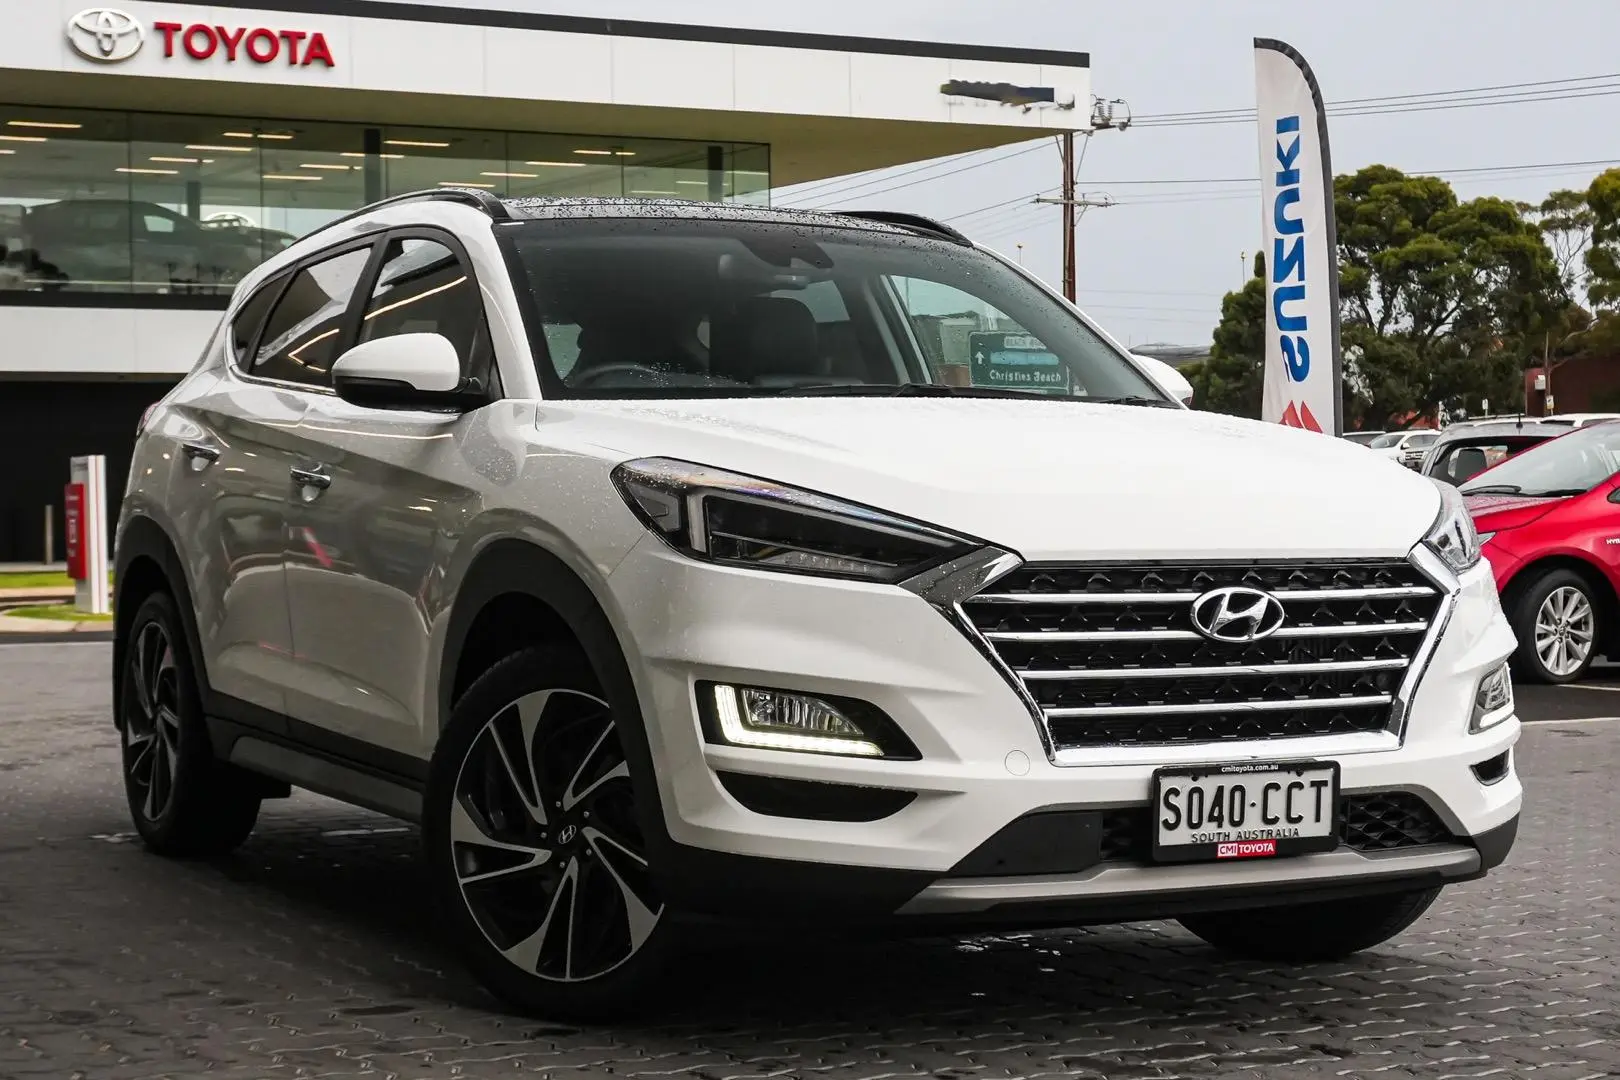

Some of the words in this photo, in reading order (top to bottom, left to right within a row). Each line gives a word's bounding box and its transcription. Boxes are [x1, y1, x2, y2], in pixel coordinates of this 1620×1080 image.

[154, 22, 335, 67] TOYOTA
[989, 369, 1031, 382] Christies
[1034, 371, 1061, 382] Beach
[1221, 764, 1279, 773] cmitoyota.com.au
[1191, 831, 1230, 843] SOUTH
[1236, 827, 1300, 840] AUSTRALIA
[1219, 844, 1237, 855] CMI
[1239, 843, 1274, 854] TOYOTA
